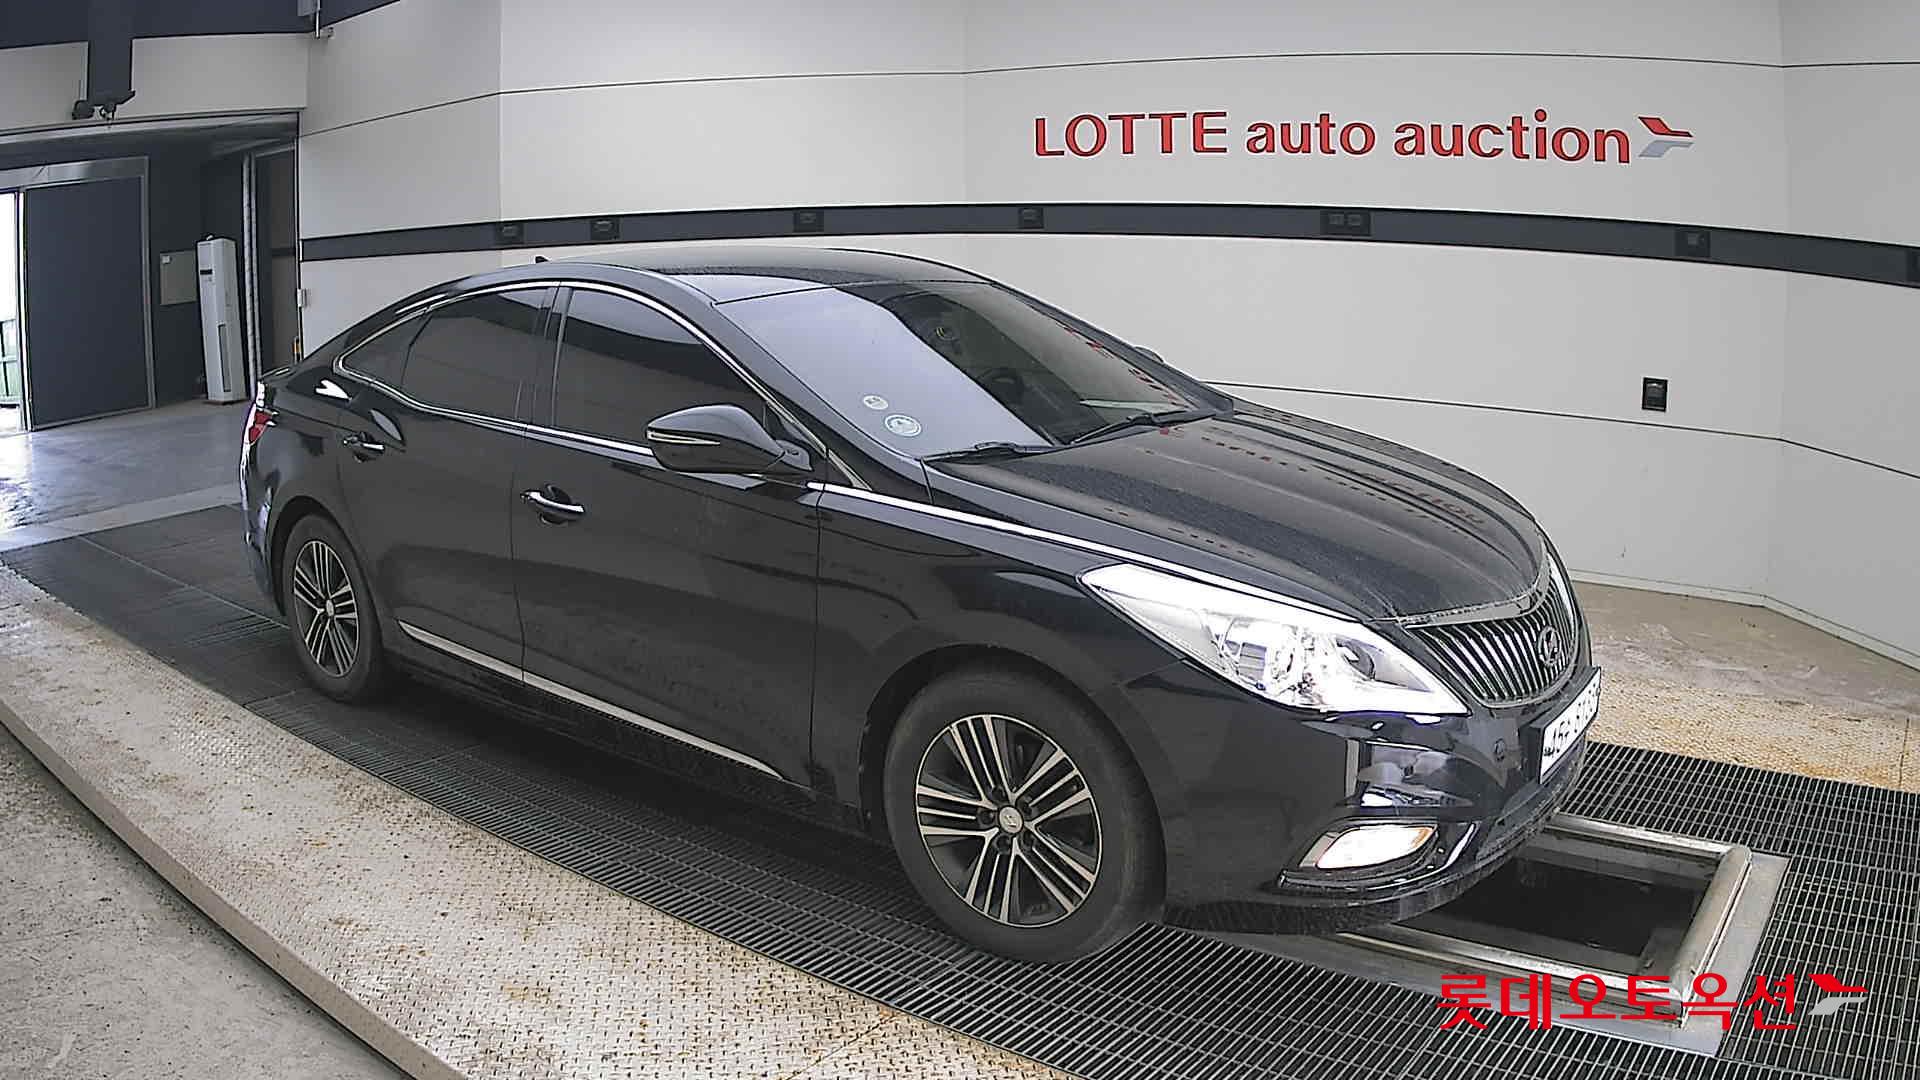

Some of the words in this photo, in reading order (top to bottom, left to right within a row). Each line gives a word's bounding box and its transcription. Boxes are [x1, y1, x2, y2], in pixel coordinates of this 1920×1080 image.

[1035, 111, 1228, 157] LOTTE
[1245, 112, 1376, 155] auto
[1393, 108, 1630, 164] auction
